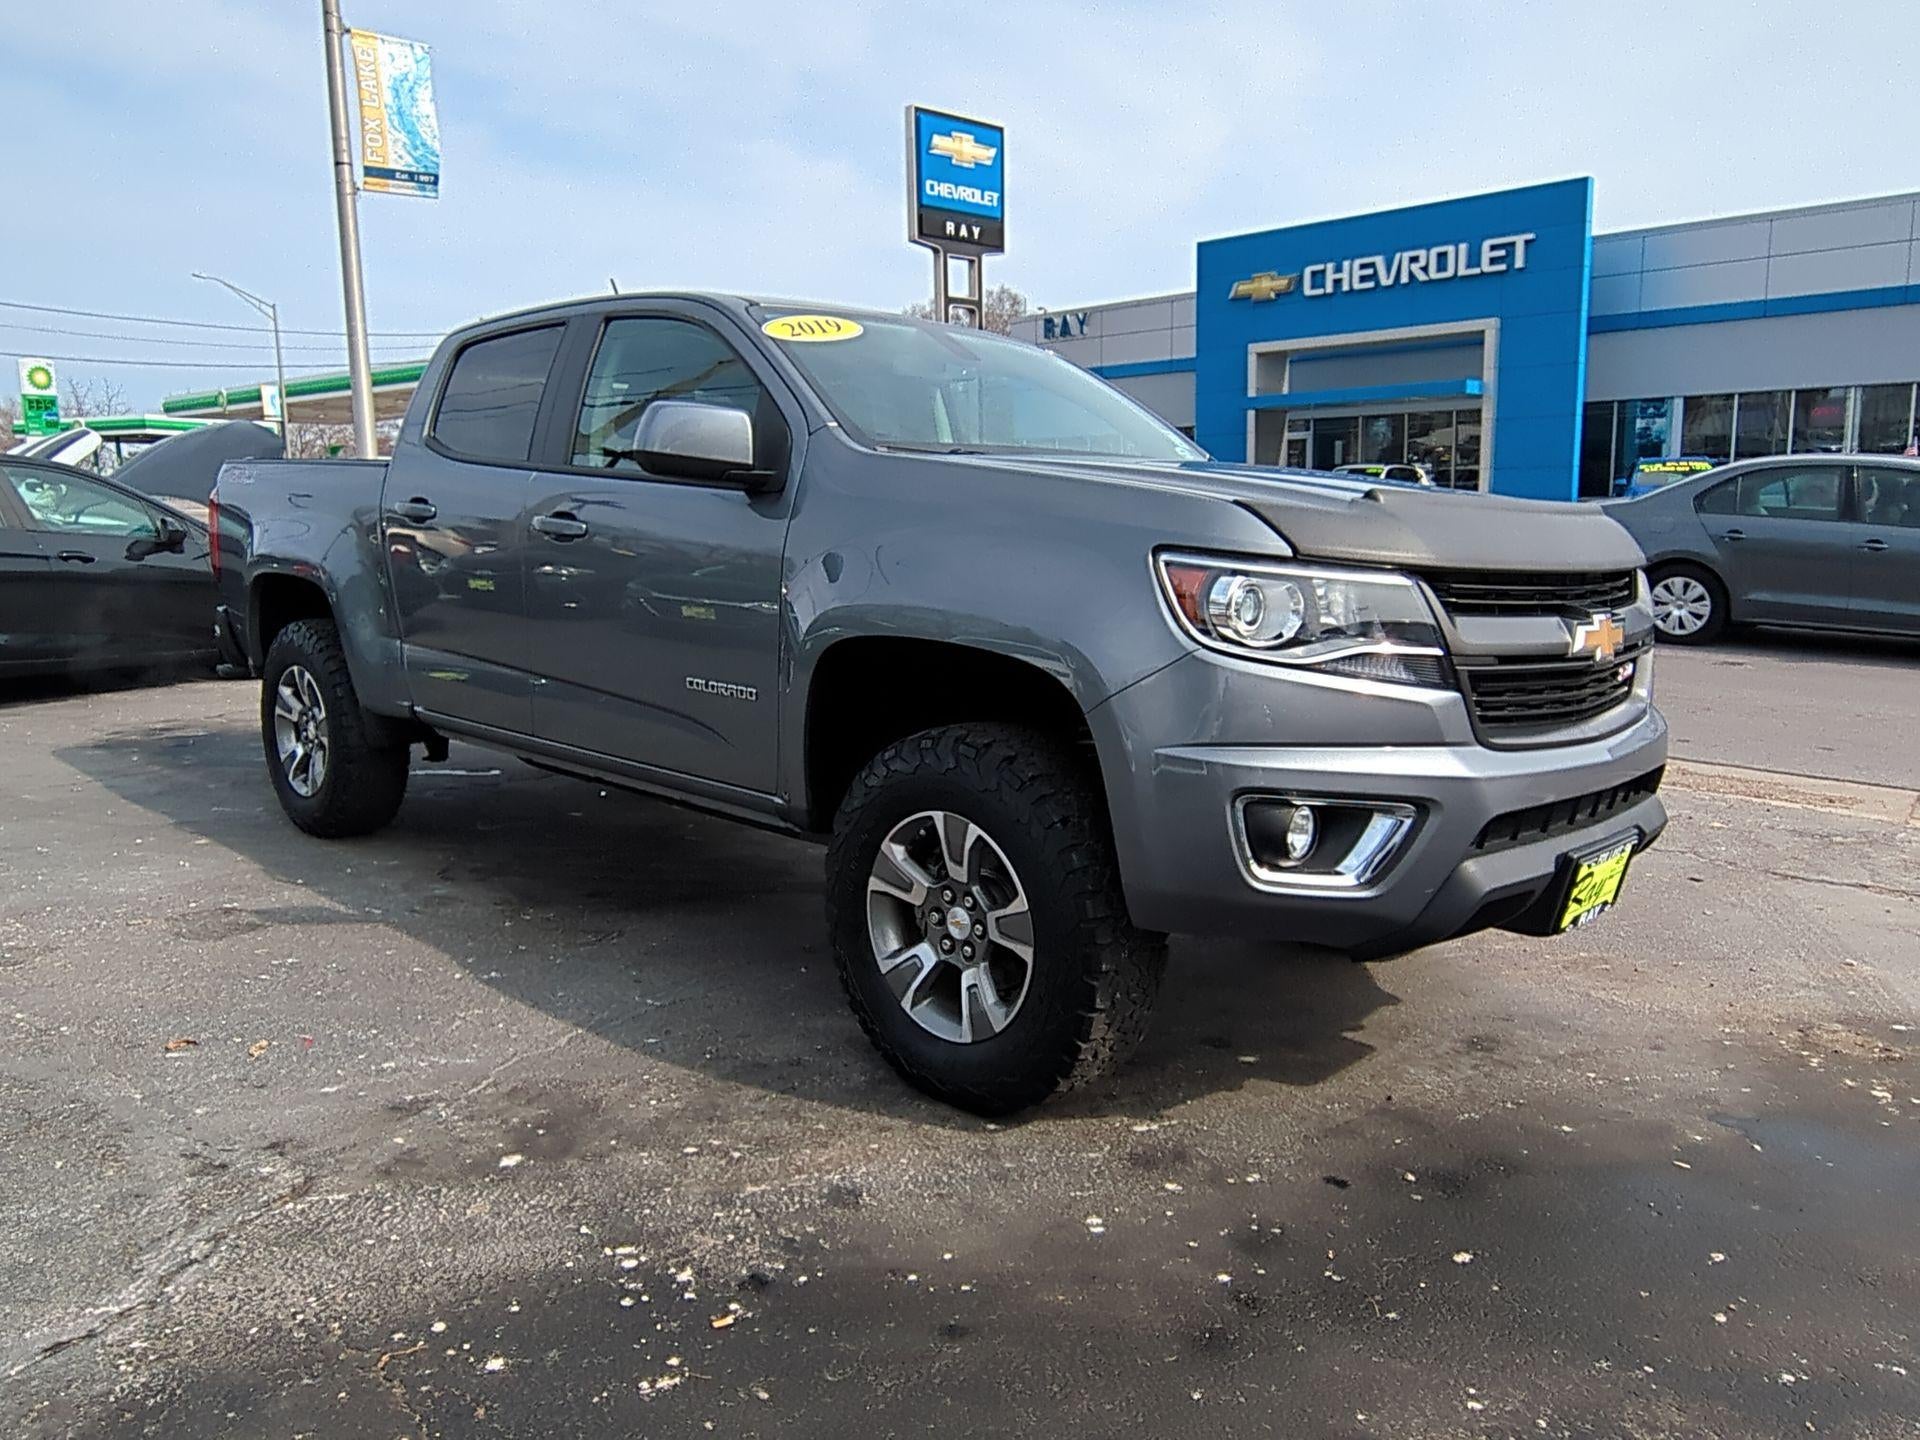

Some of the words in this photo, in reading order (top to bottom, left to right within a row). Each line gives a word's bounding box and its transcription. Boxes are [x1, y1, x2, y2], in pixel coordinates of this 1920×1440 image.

[360, 46, 380, 110] LAKE
[364, 118, 385, 165] FOX
[925, 179, 999, 208] CHEVROLET
[945, 220, 981, 240] RAY
[1302, 231, 1536, 298] CHEVROLET
[781, 318, 842, 338] 2019
[1043, 311, 1090, 340] RAY
[685, 676, 757, 702] COLORADO
